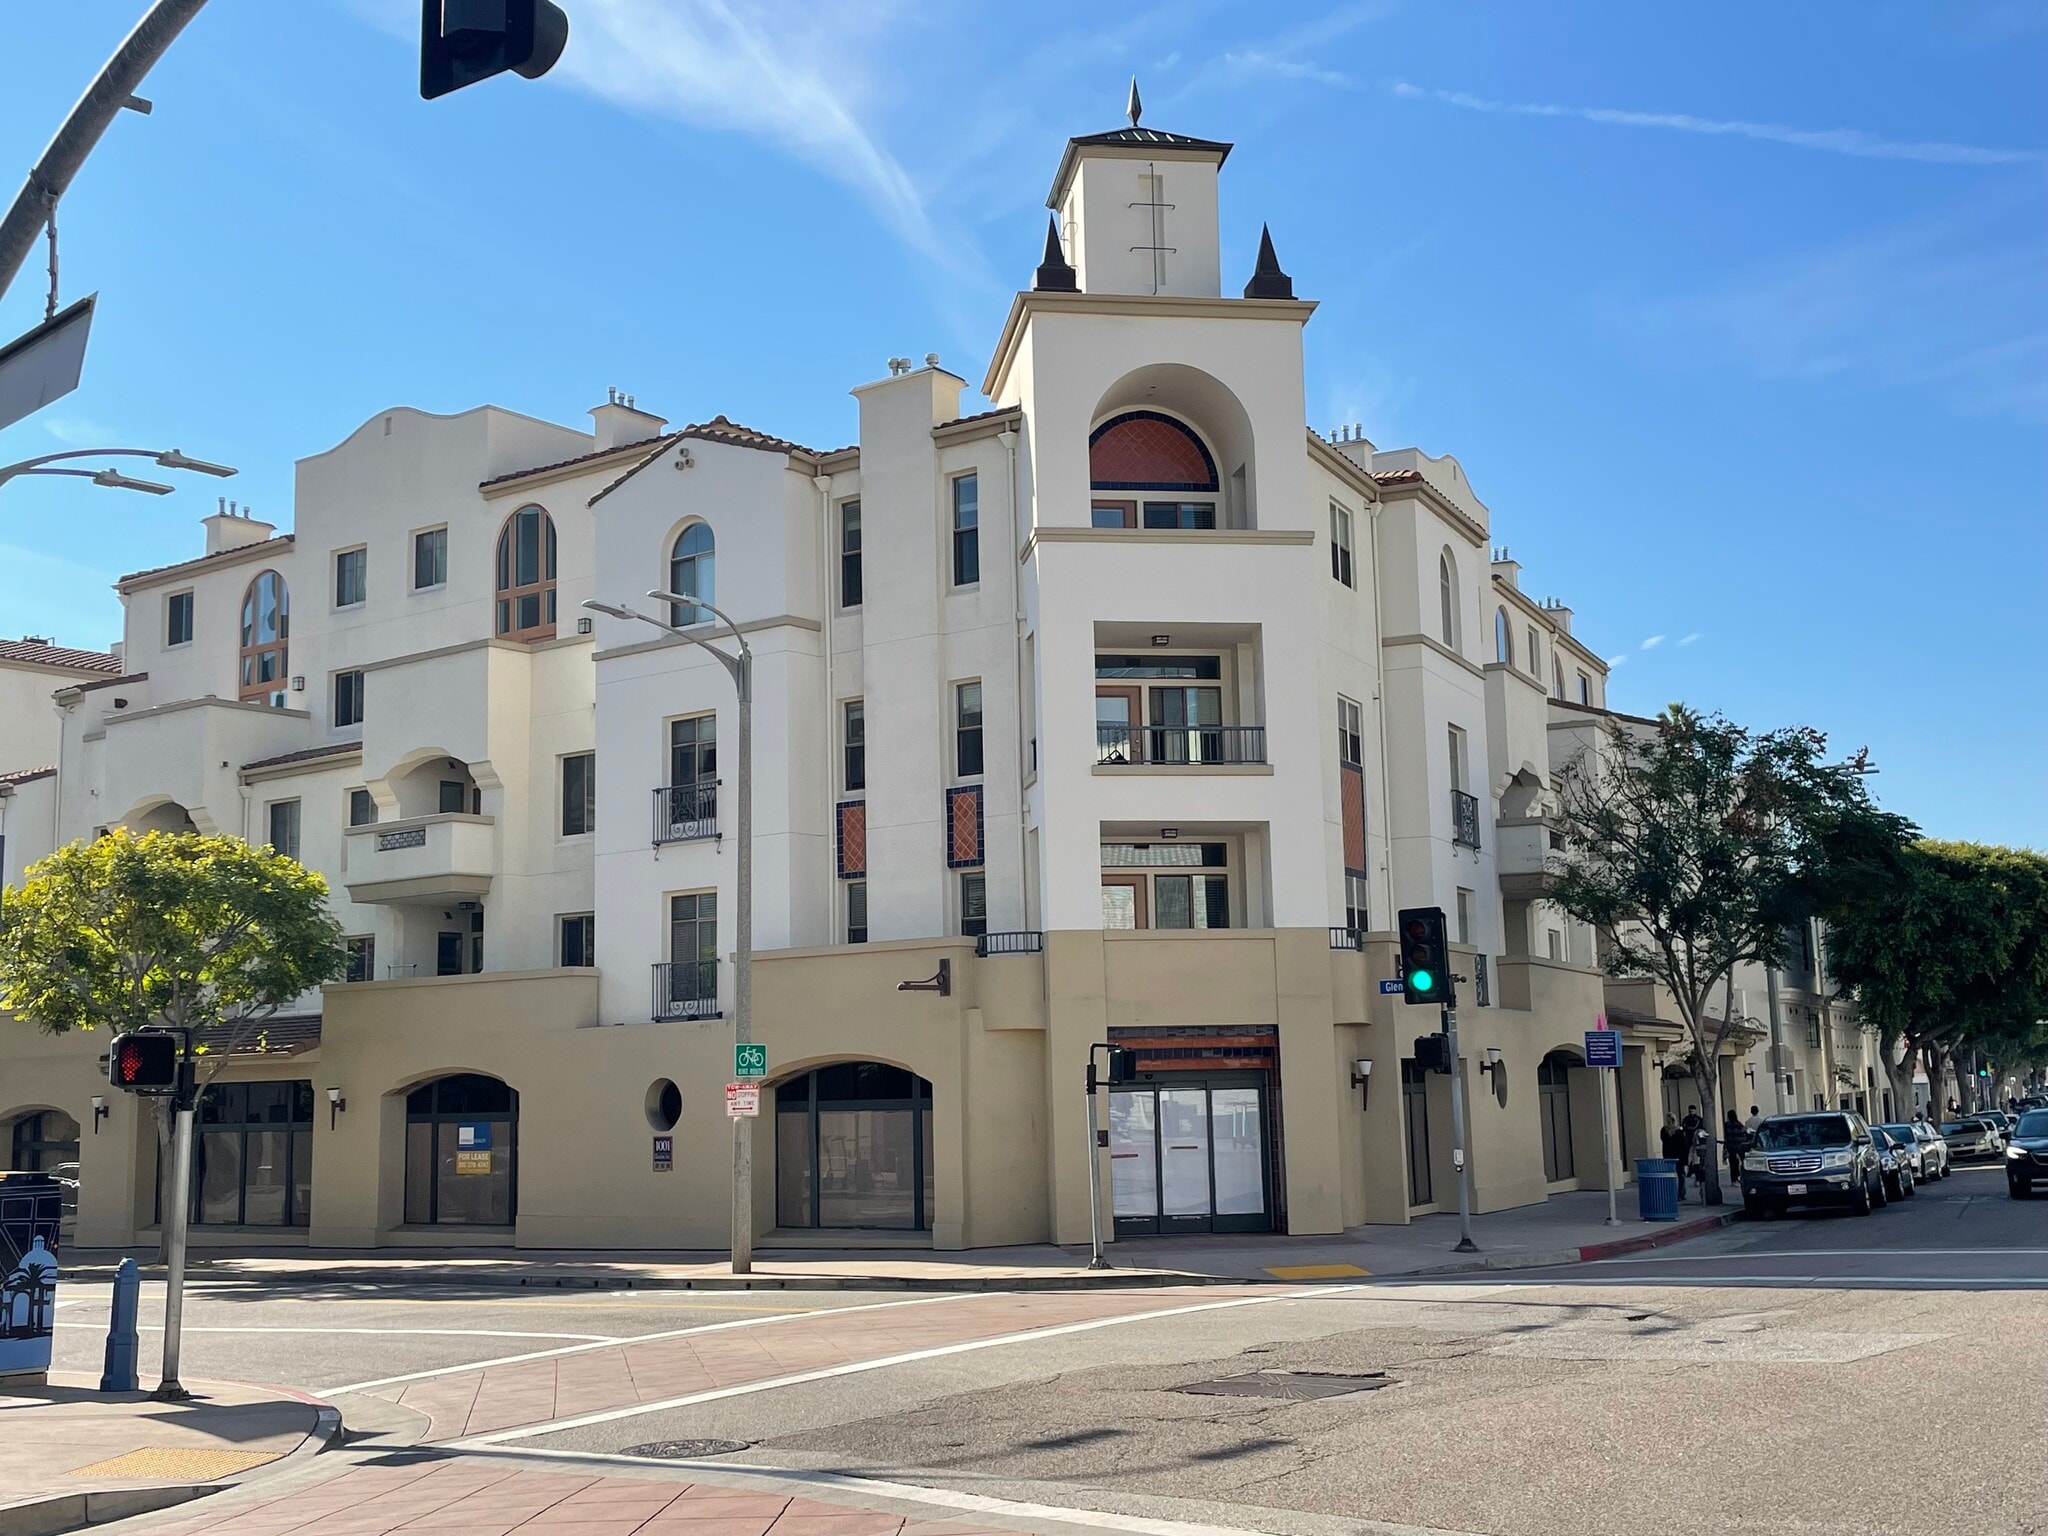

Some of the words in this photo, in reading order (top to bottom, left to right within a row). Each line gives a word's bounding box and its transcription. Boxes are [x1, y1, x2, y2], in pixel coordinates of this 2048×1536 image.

[1386, 981, 1403, 992] Glen
[727, 1091, 736, 1099] NO
[655, 1140, 670, 1151] 1001
